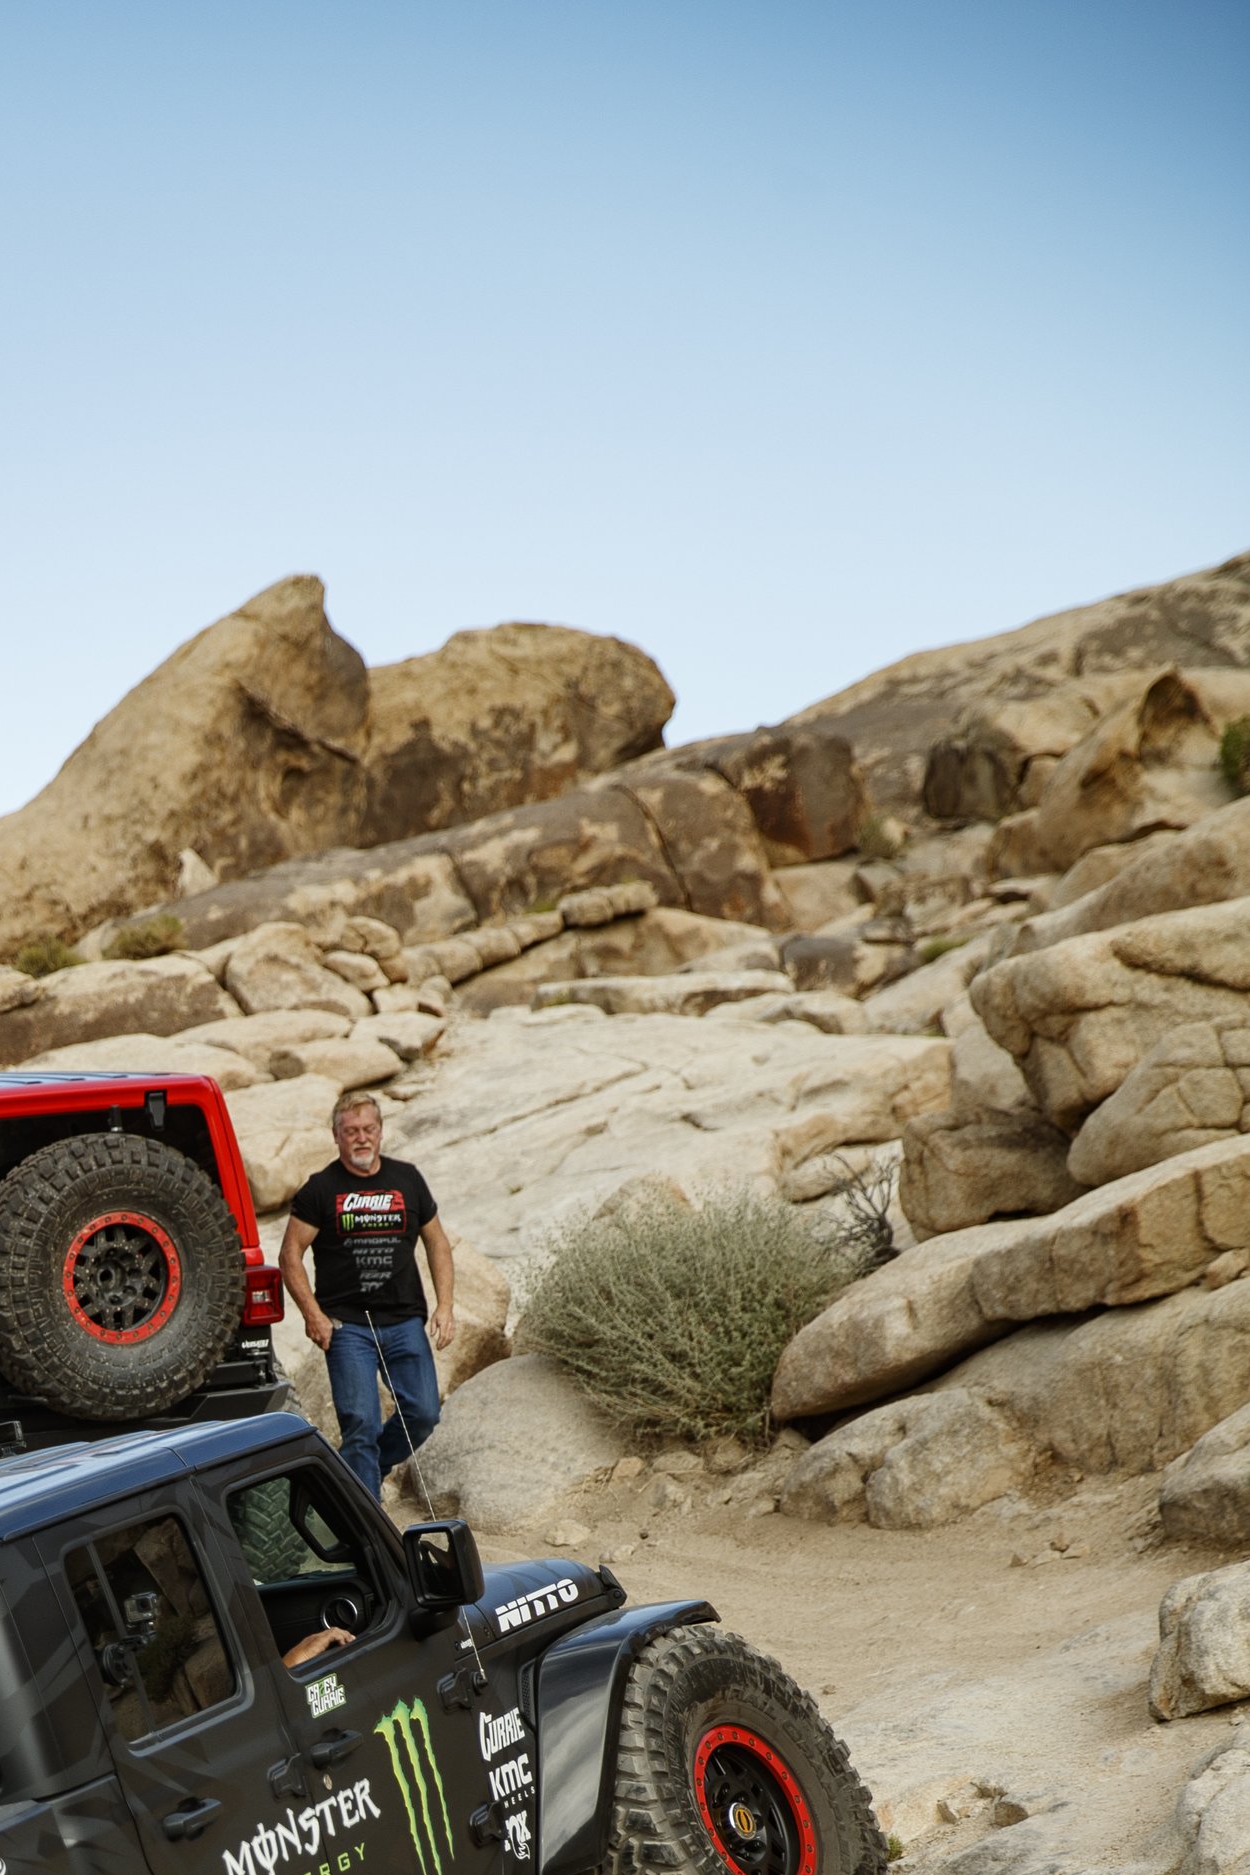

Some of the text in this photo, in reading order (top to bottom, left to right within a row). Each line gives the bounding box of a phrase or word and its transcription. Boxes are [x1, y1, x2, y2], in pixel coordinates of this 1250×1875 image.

[343, 1193, 393, 1212] CURRIE
[355, 1255, 393, 1265] KMC
[494, 1578, 579, 1633] NITTO
[312, 1687, 346, 1716] CURRIE
[479, 1706, 526, 1762] CURRIE
[488, 1753, 533, 1801] KMC
[503, 1785, 535, 1809] HEELS
